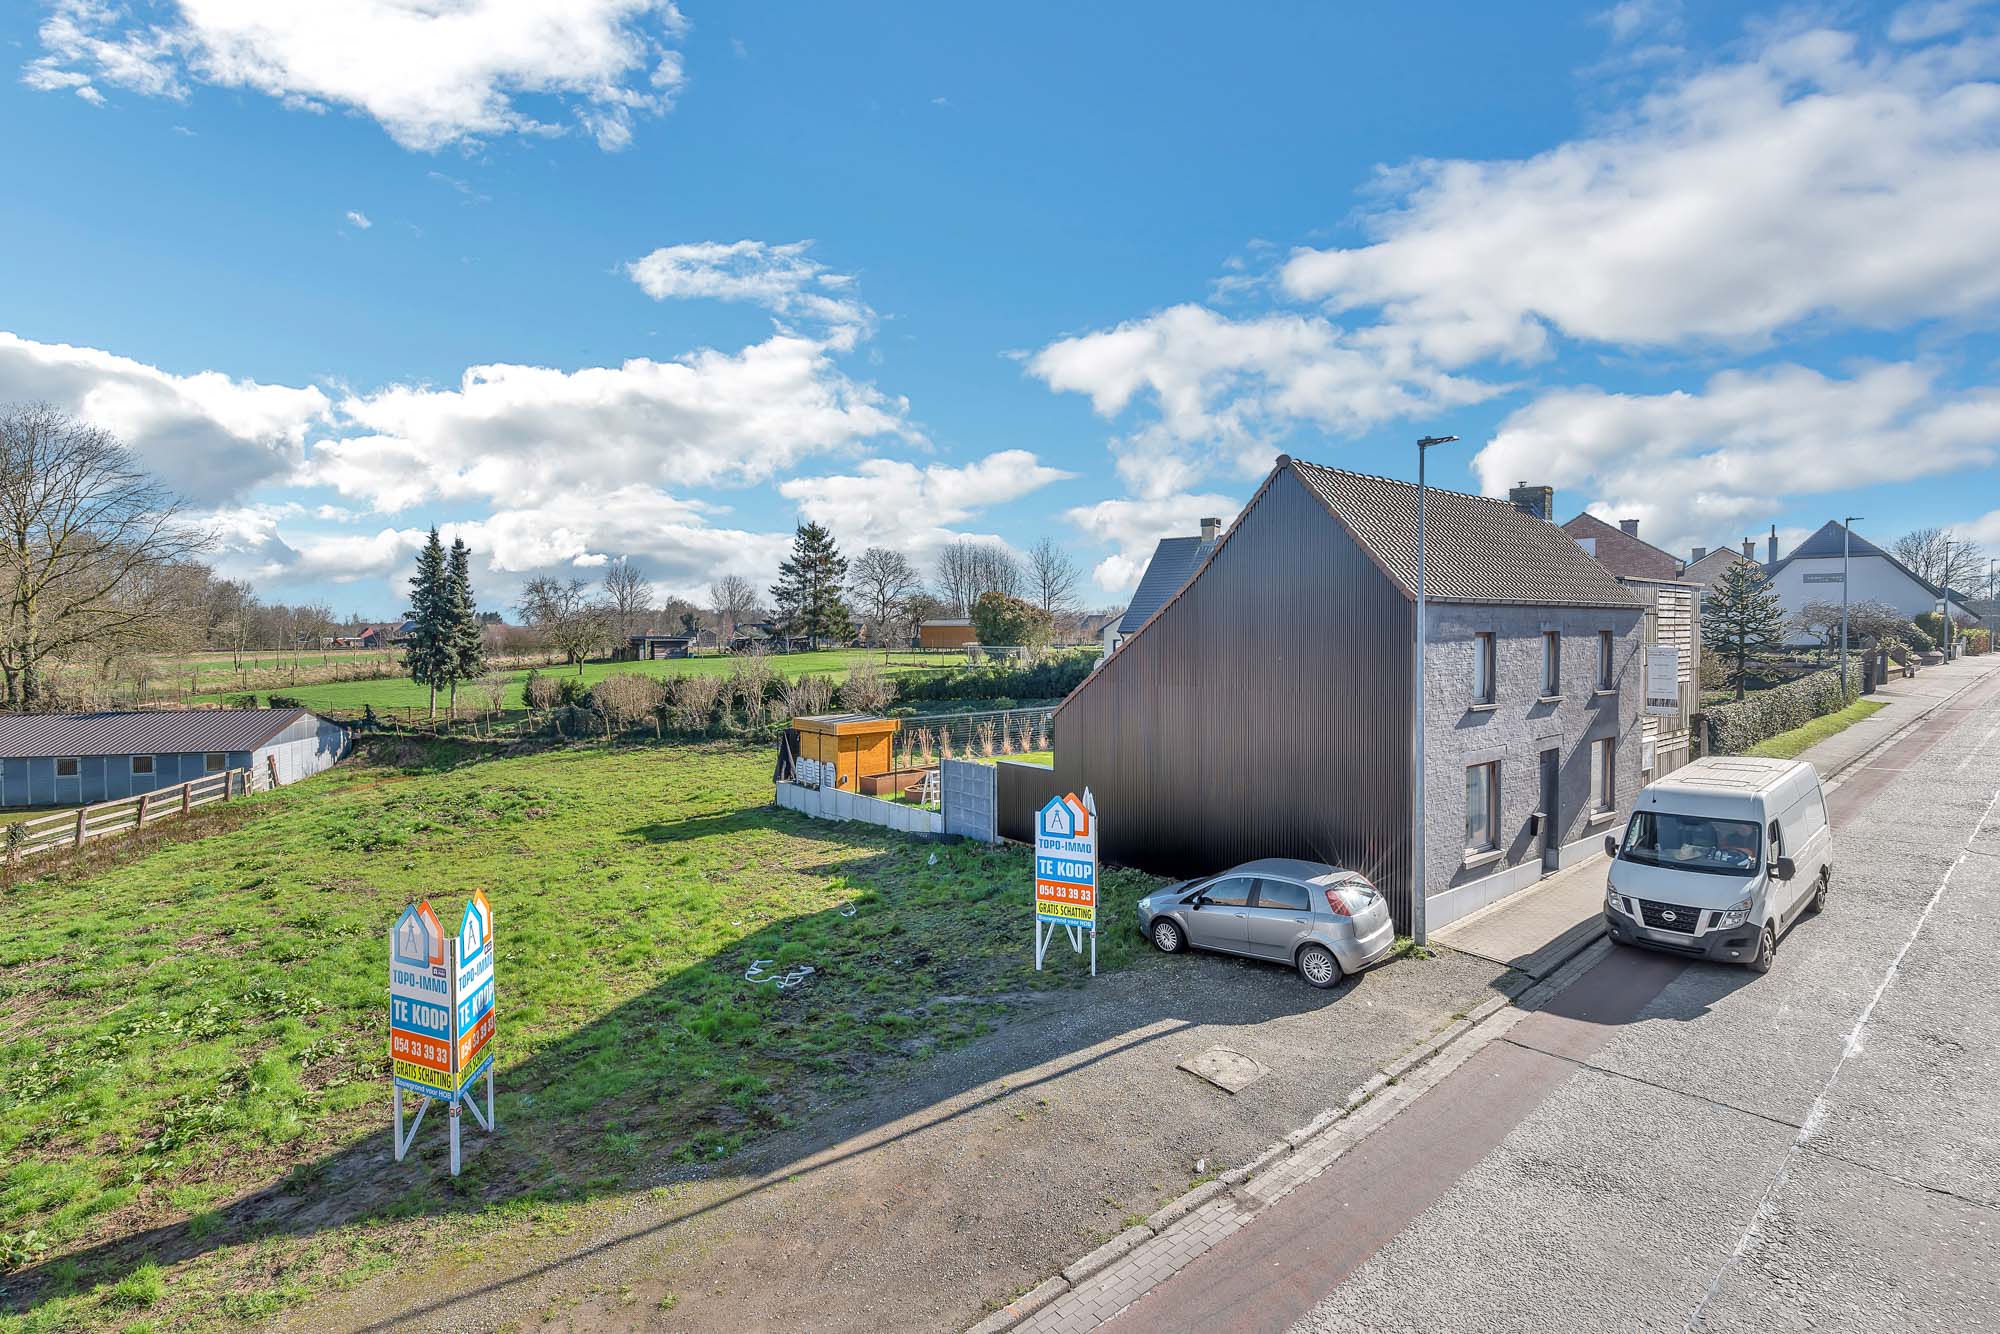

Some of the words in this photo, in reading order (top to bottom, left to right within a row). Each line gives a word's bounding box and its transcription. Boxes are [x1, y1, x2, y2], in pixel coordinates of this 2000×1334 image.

[1039, 839, 1092, 853] TOPO-IMMO
[1040, 859, 1053, 874] TE
[1057, 861, 1092, 878] KOOP
[1039, 884, 1054, 895] 054
[1056, 886, 1066, 897] 33
[1068, 888, 1079, 899] 39
[1080, 889, 1091, 900] 33
[1039, 902, 1059, 914] GRATIS
[1060, 904, 1092, 919] SCHATTING
[393, 969, 448, 994] TOPO-IMMO
[459, 951, 493, 991] TOPO-IMMO
[393, 999, 408, 1022] TE
[412, 1003, 449, 1031] KOOP
[459, 1002, 471, 1028] TE
[472, 981, 495, 1017] KOOP
[394, 1036, 409, 1053] 054
[411, 1040, 422, 1056] 33
[424, 1043, 434, 1060] 39
[436, 1047, 448, 1064] 33
[460, 1036, 472, 1059] 054
[396, 1060, 417, 1079] GRATIS
[418, 1066, 452, 1088] SCHATTING
